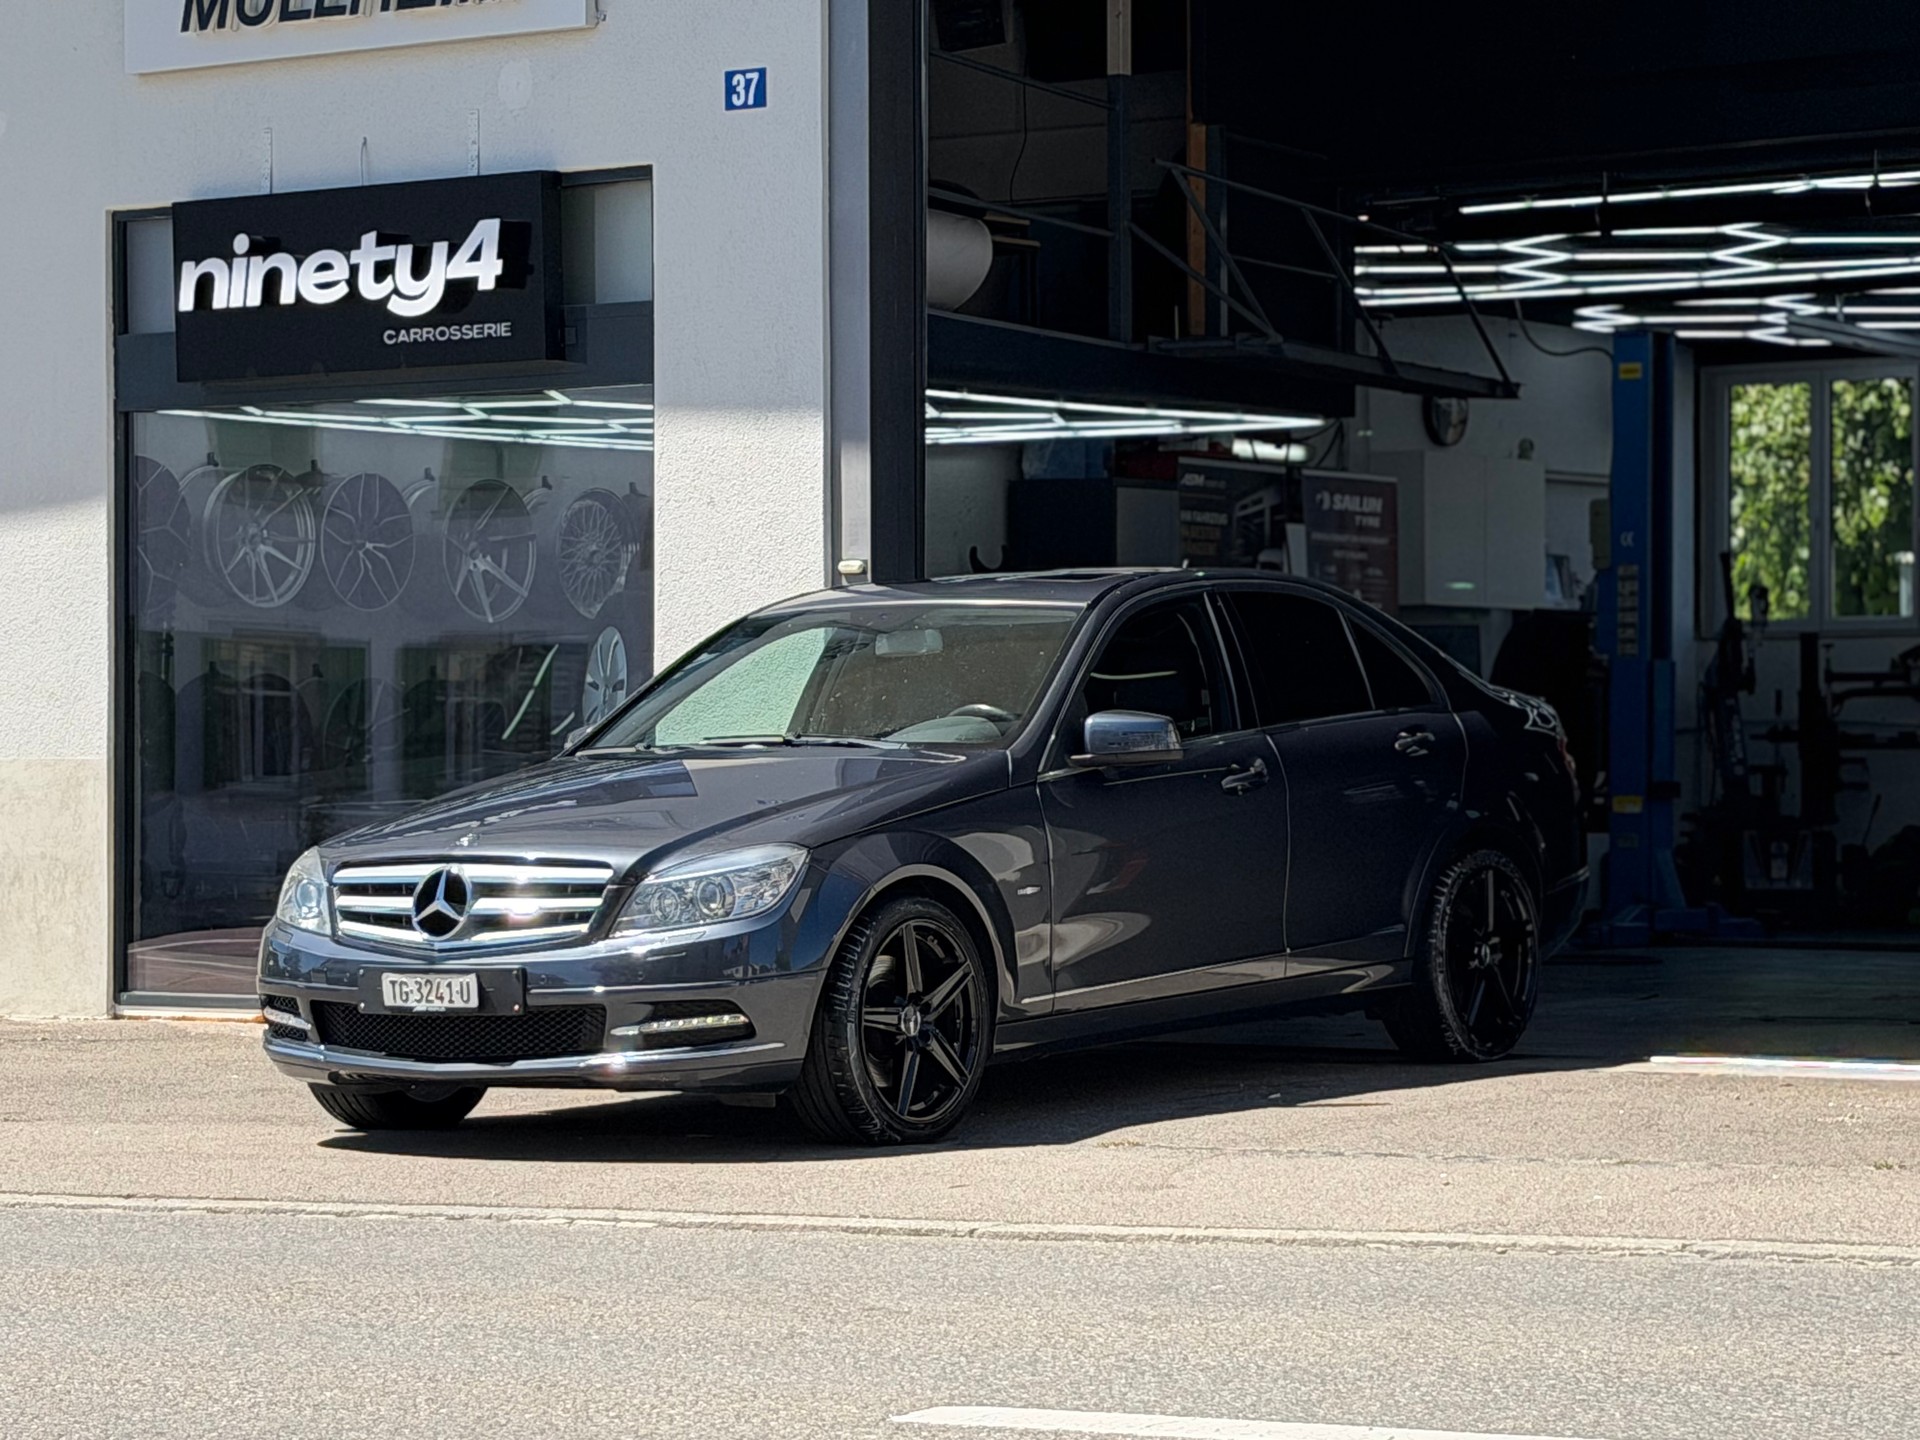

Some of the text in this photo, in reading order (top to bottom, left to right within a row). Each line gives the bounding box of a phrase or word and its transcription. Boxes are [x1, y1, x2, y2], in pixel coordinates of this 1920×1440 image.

[731, 71, 760, 107] 37
[178, 218, 503, 317] ninety4
[383, 321, 512, 345] CARROSSERIE
